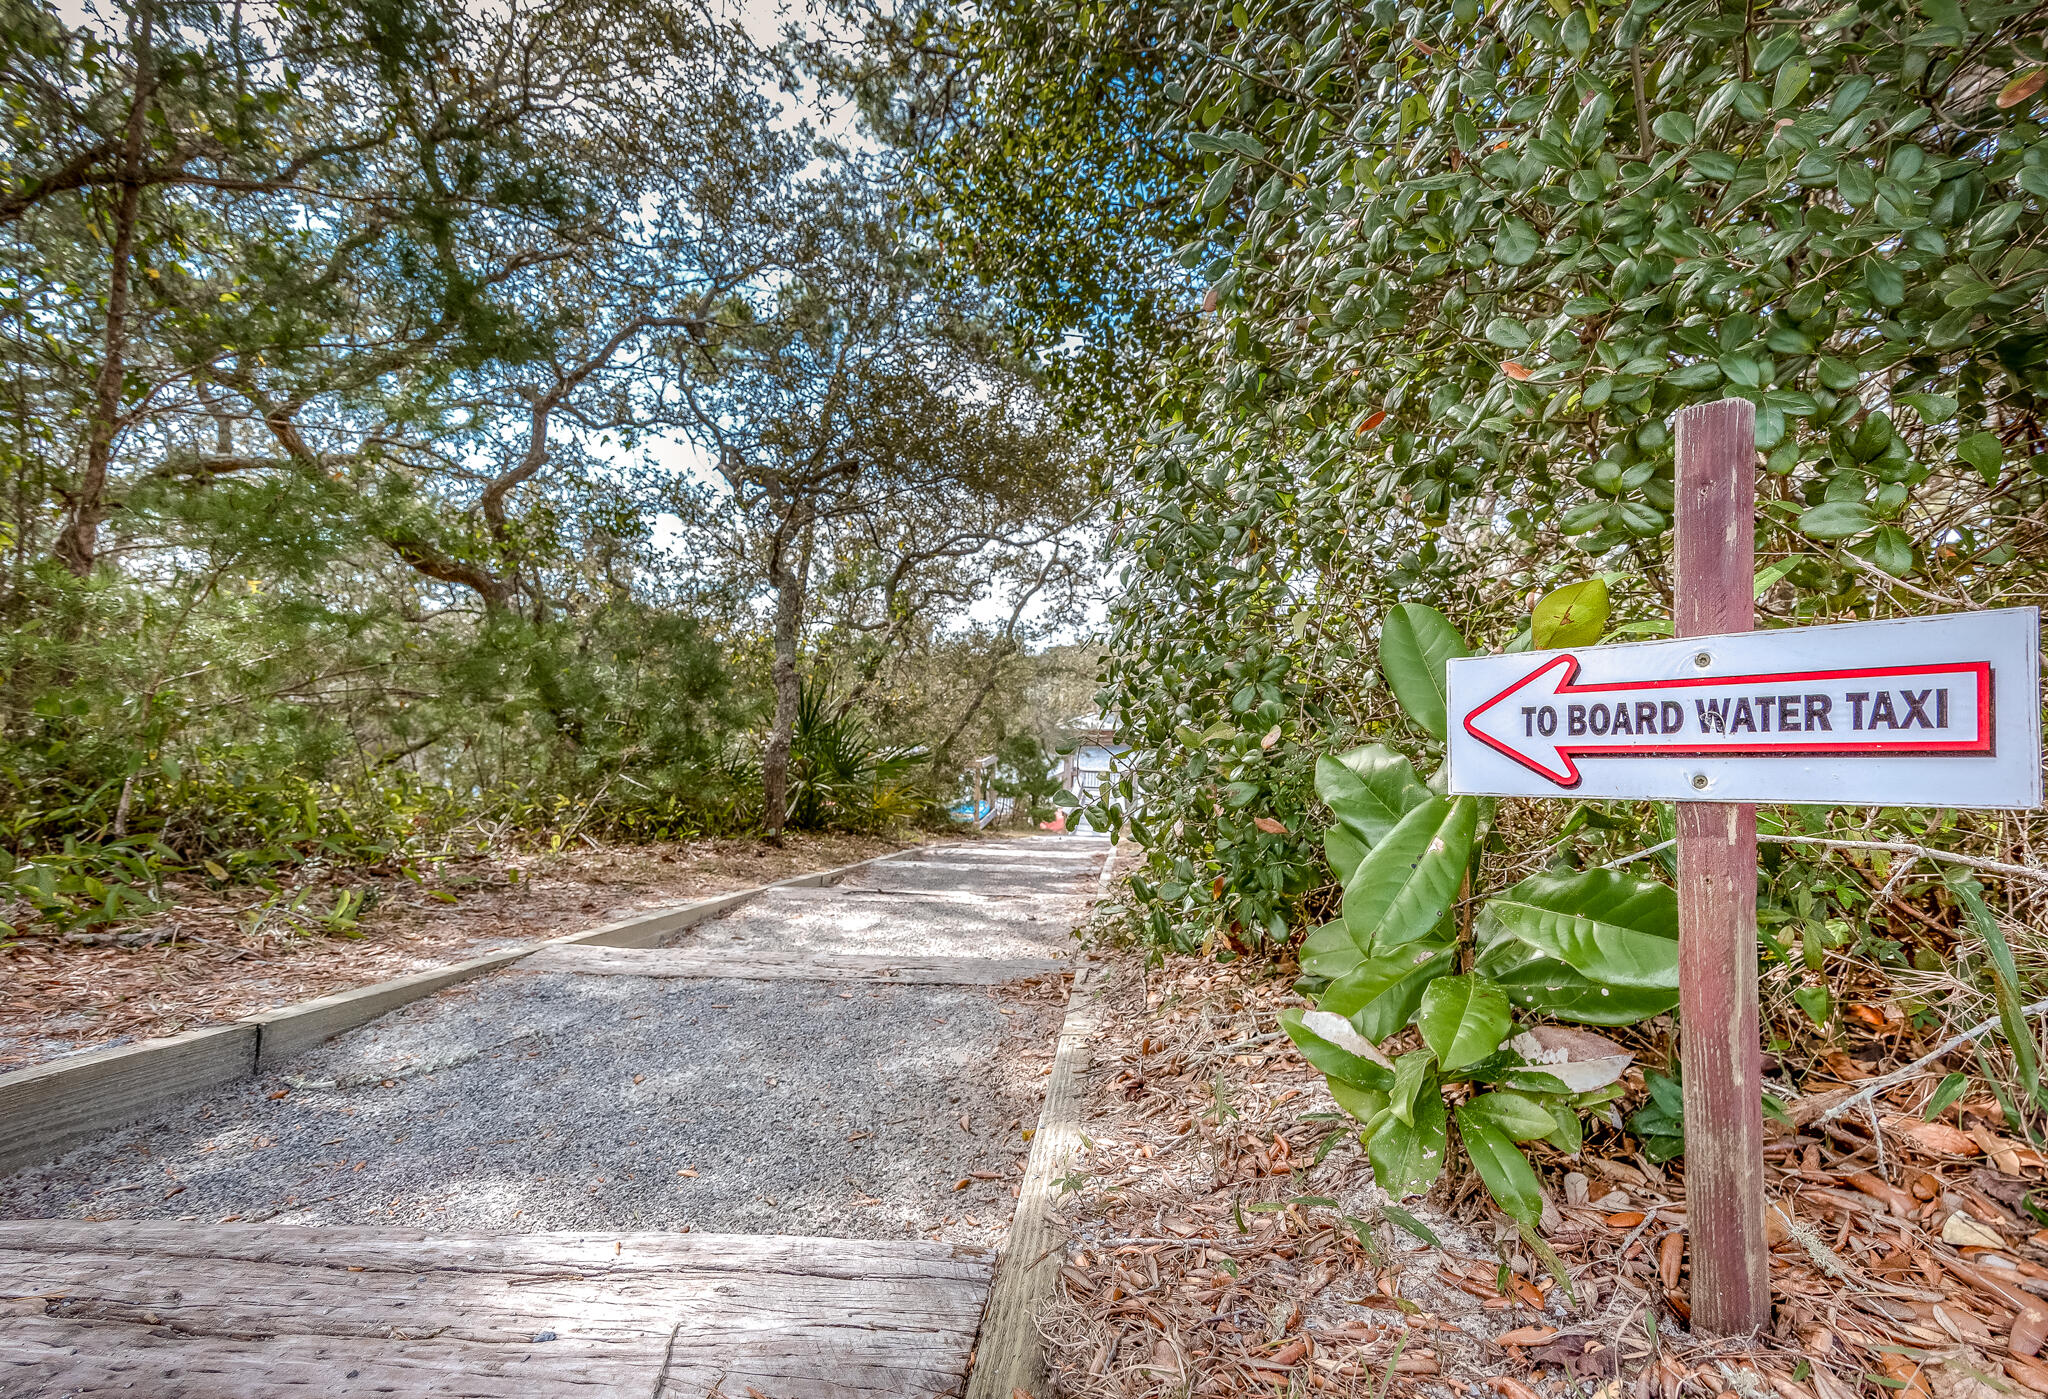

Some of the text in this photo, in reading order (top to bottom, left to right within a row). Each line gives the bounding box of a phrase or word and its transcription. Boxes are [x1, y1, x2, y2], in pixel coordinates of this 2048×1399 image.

[1521, 688, 1949, 737] TO BOARD WATER TAXI
